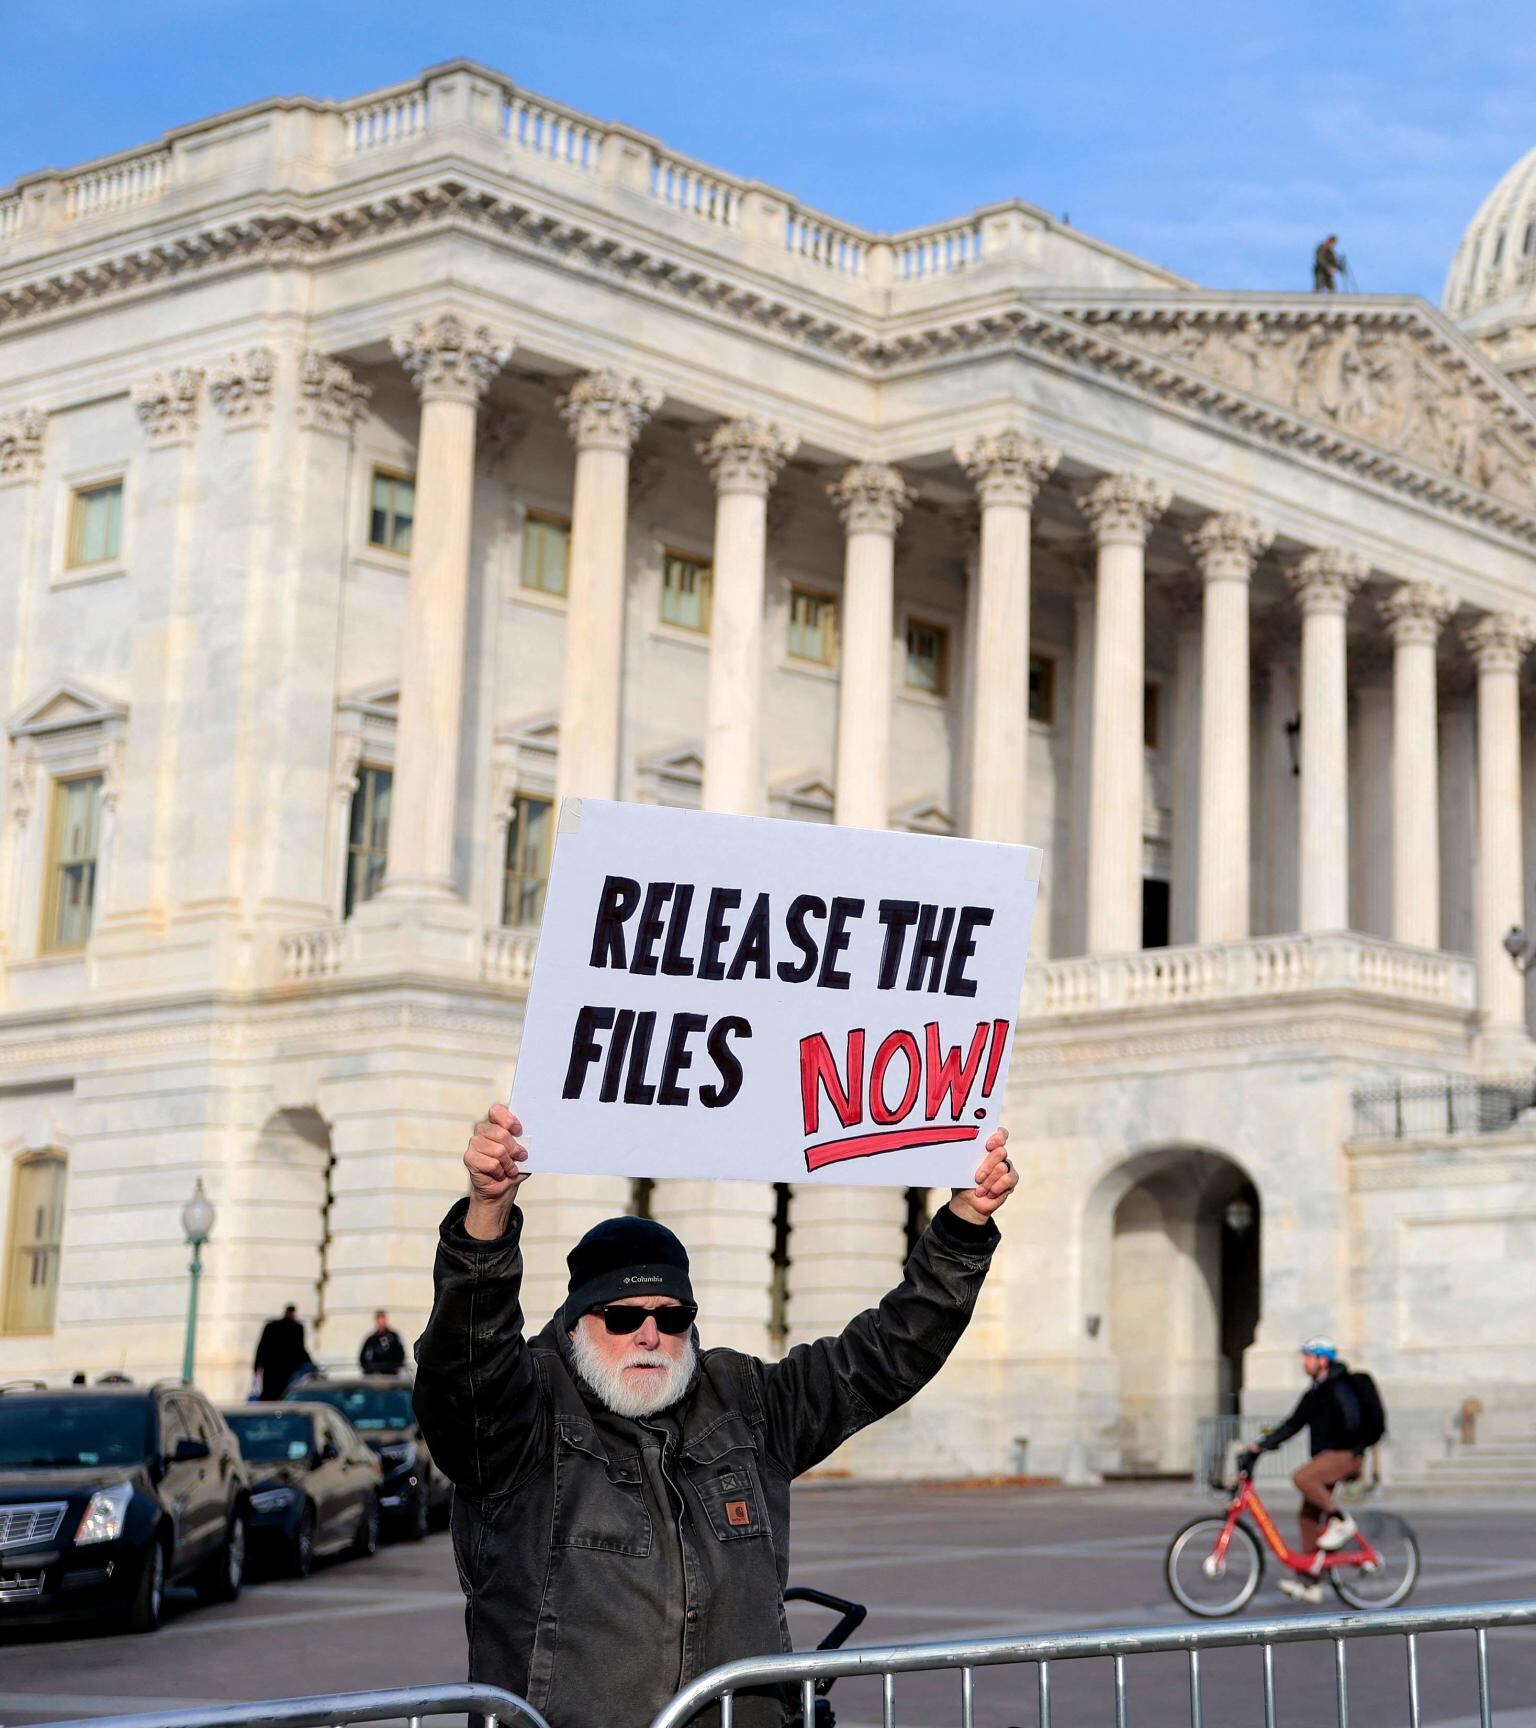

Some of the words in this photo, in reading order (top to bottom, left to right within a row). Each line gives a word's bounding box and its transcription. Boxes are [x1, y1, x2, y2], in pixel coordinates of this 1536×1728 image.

[588, 874, 866, 990] RELEASE
[876, 898, 995, 998] THE
[561, 1005, 753, 1109] FILES
[798, 1018, 1010, 1137] NOW!
[631, 1275, 663, 1283] Columbia
